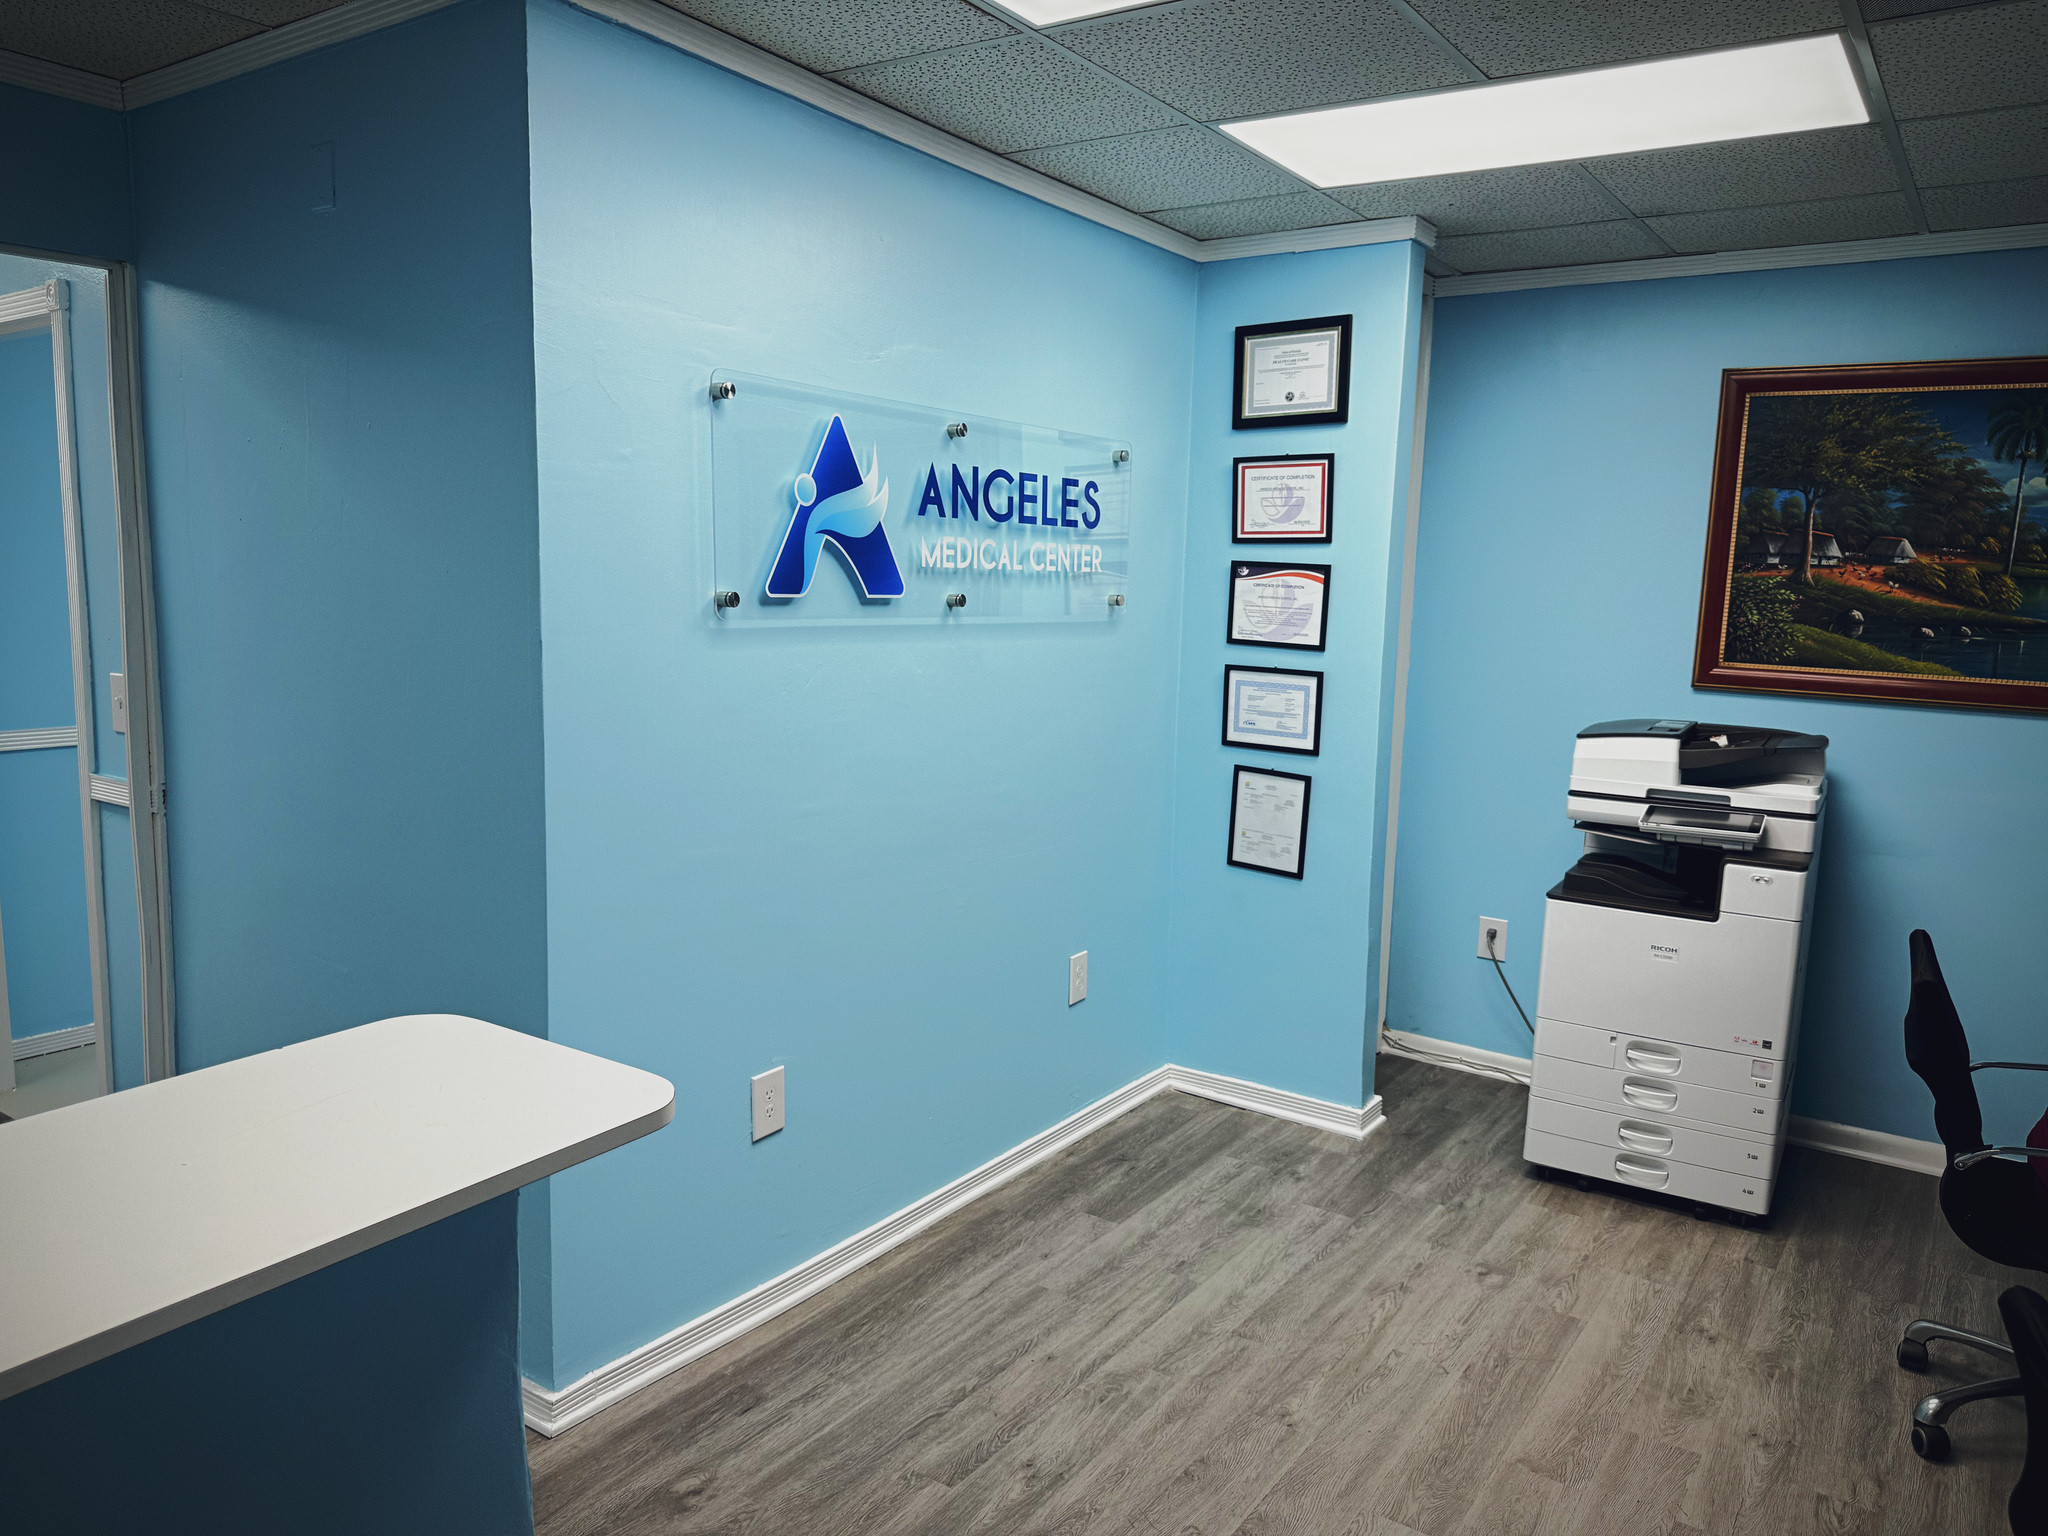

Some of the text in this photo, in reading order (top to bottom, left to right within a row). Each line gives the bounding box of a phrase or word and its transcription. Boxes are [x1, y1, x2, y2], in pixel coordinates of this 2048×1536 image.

[917, 461, 1101, 530] ANGELES
[921, 535, 1102, 573] MEDICAL CENTER
[1650, 944, 1678, 953] RICOH
